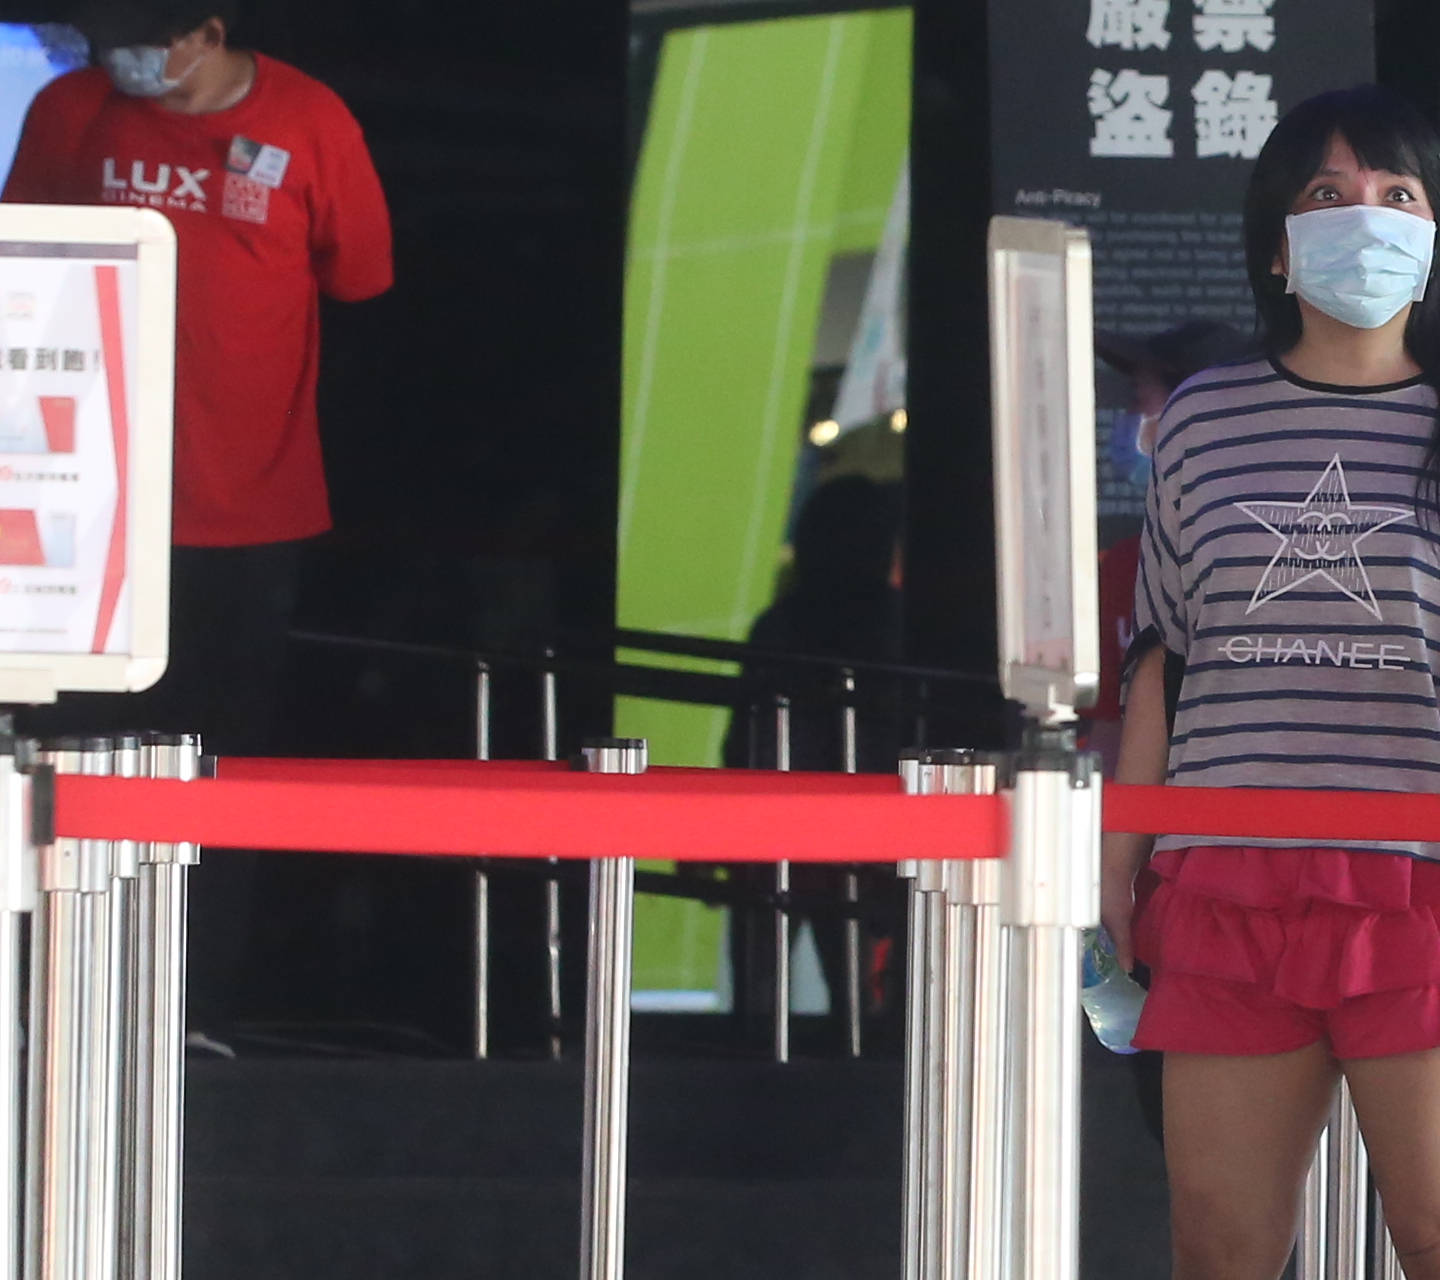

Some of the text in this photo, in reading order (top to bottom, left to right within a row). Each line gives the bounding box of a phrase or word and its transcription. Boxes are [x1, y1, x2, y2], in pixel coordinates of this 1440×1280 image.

[1086, 67, 1280, 160] 盜錄
[103, 158, 211, 201] LUX
[102, 190, 207, 213] CINEMA
[1015, 188, 1101, 207] Anti-Piracy
